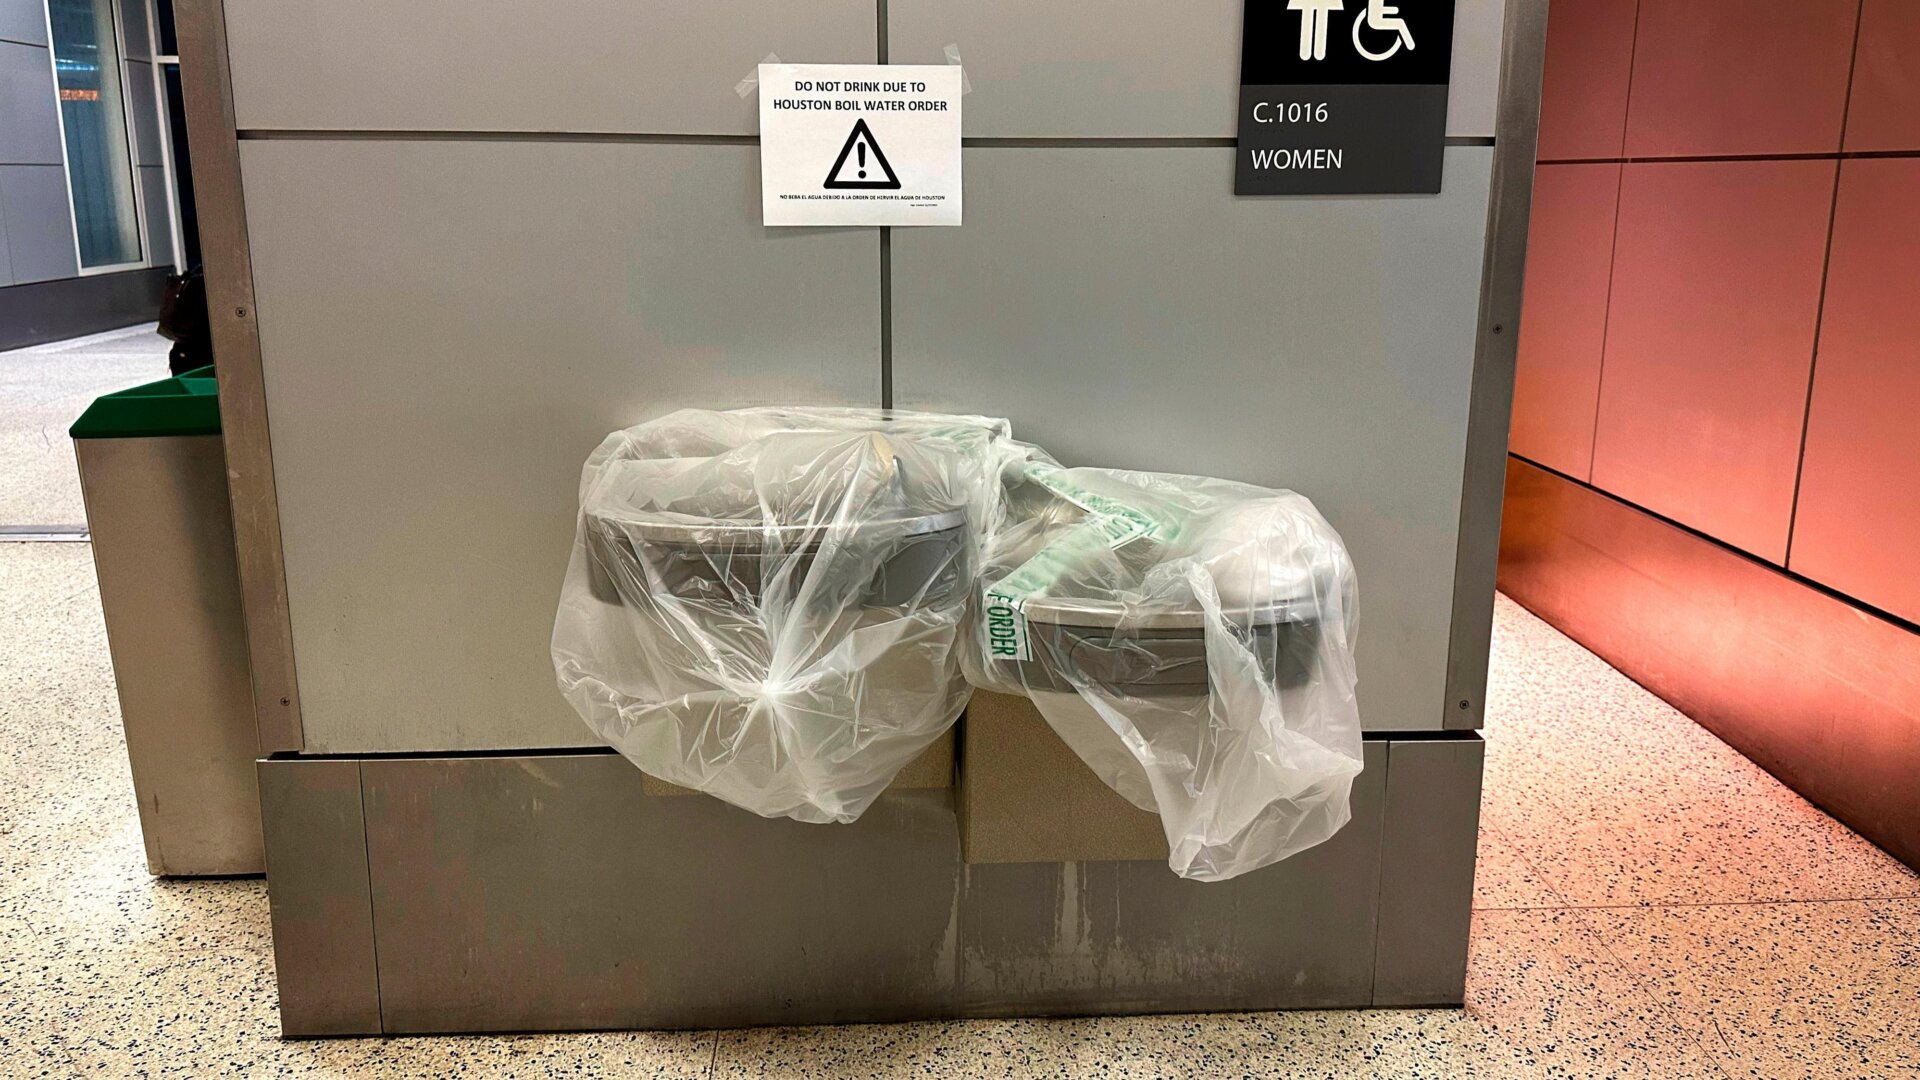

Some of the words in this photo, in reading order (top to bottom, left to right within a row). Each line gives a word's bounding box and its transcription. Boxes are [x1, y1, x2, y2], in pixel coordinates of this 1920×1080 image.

[795, 81, 813, 92] DO
[816, 81, 841, 92] NOT
[844, 82, 880, 92] DRINK
[883, 82, 907, 92] DUE
[910, 82, 926, 92] TO
[773, 99, 832, 110] HOUSTON
[835, 100, 861, 111] BOIL
[864, 100, 905, 111] WATER
[908, 101, 948, 111] ORDER
[1253, 102, 1329, 123] C.1016
[1251, 149, 1343, 170] WOMEN
[987, 606, 1017, 655] ORDER
